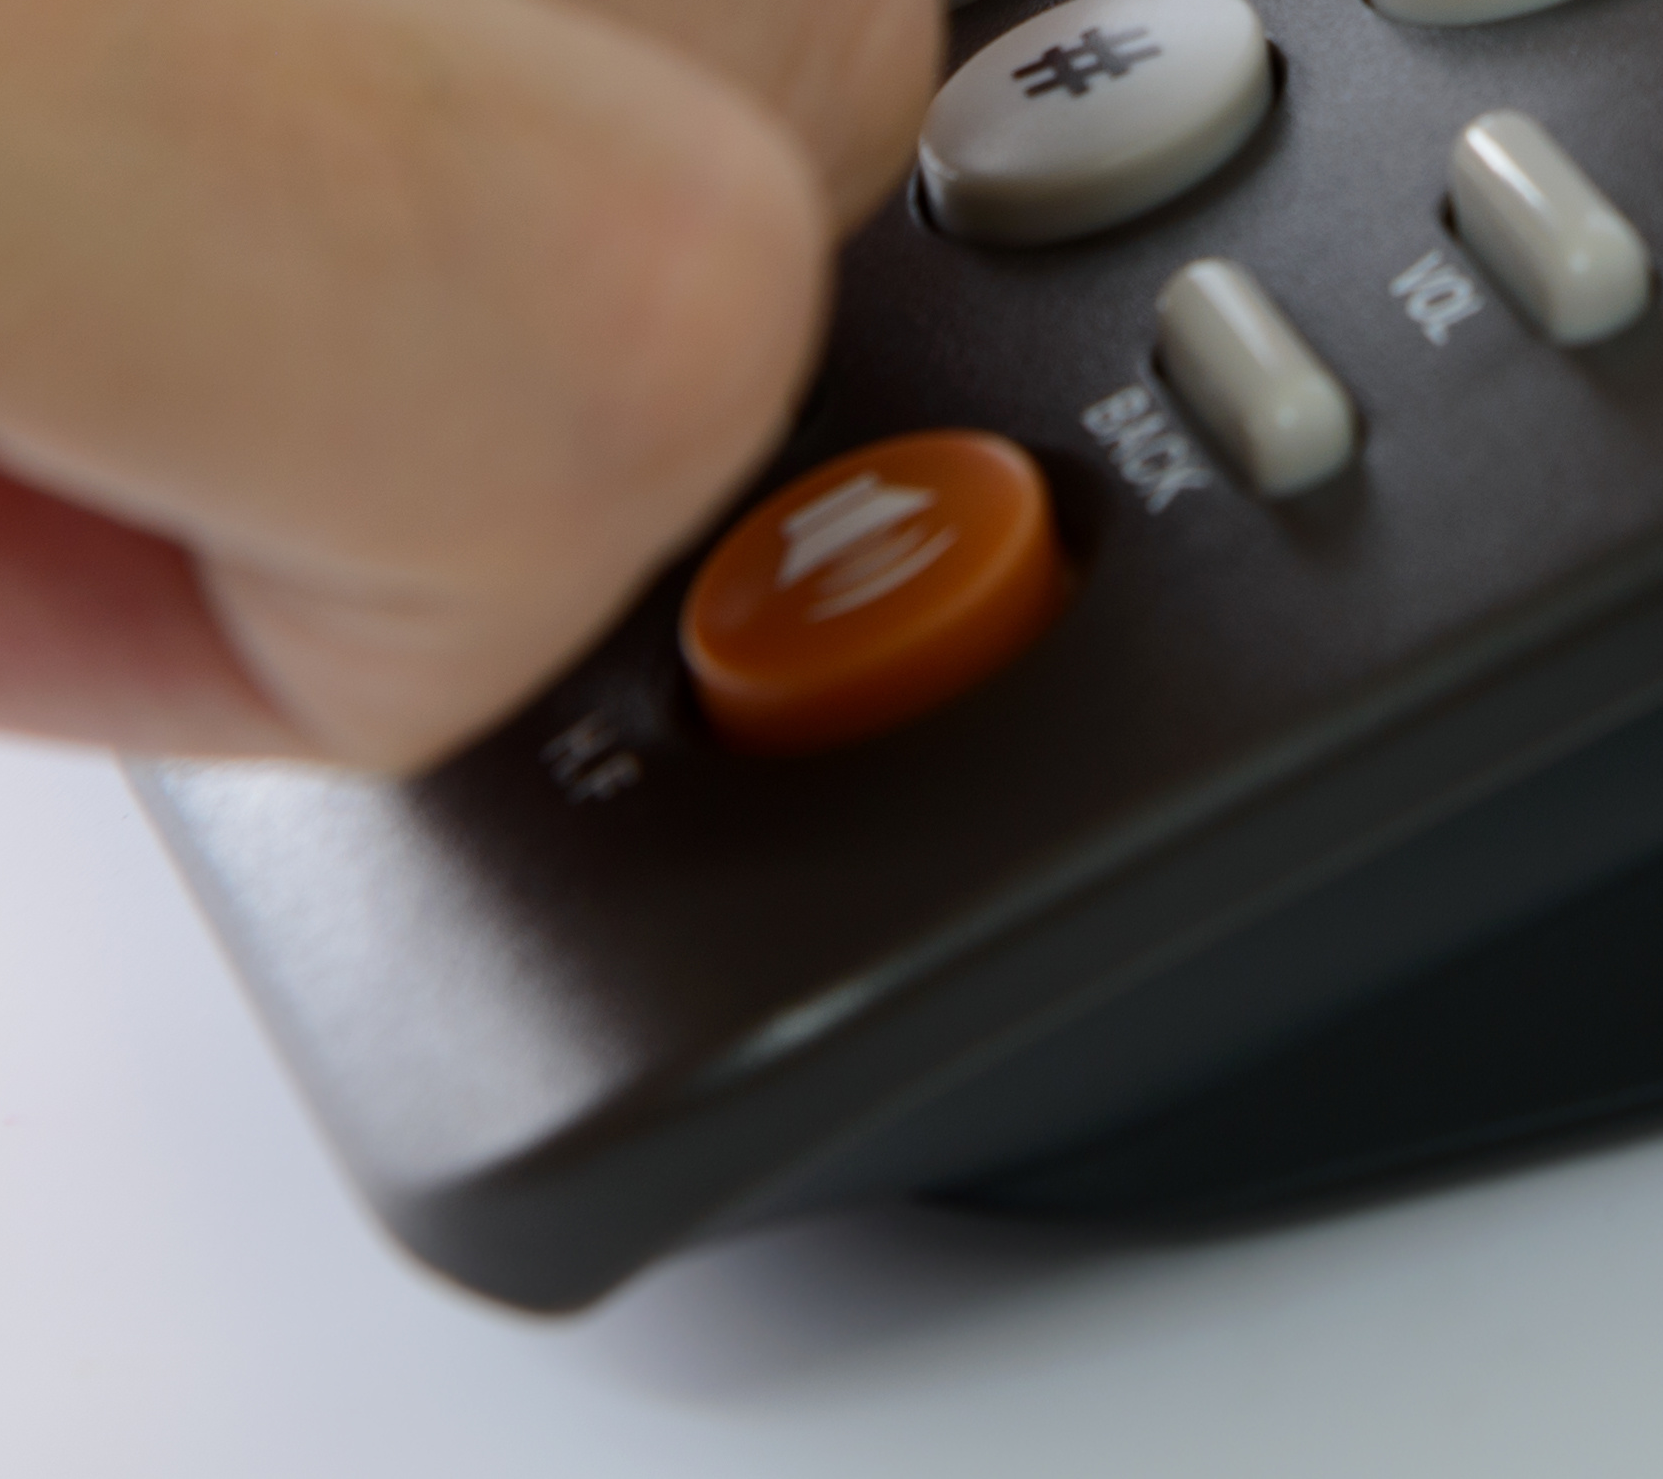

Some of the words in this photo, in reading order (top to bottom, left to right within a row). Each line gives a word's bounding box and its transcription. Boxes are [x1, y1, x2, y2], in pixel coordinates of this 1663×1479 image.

[1011, 25, 1162, 98] #
[1387, 249, 1485, 347] VOL
[1082, 385, 1215, 516] BACK
